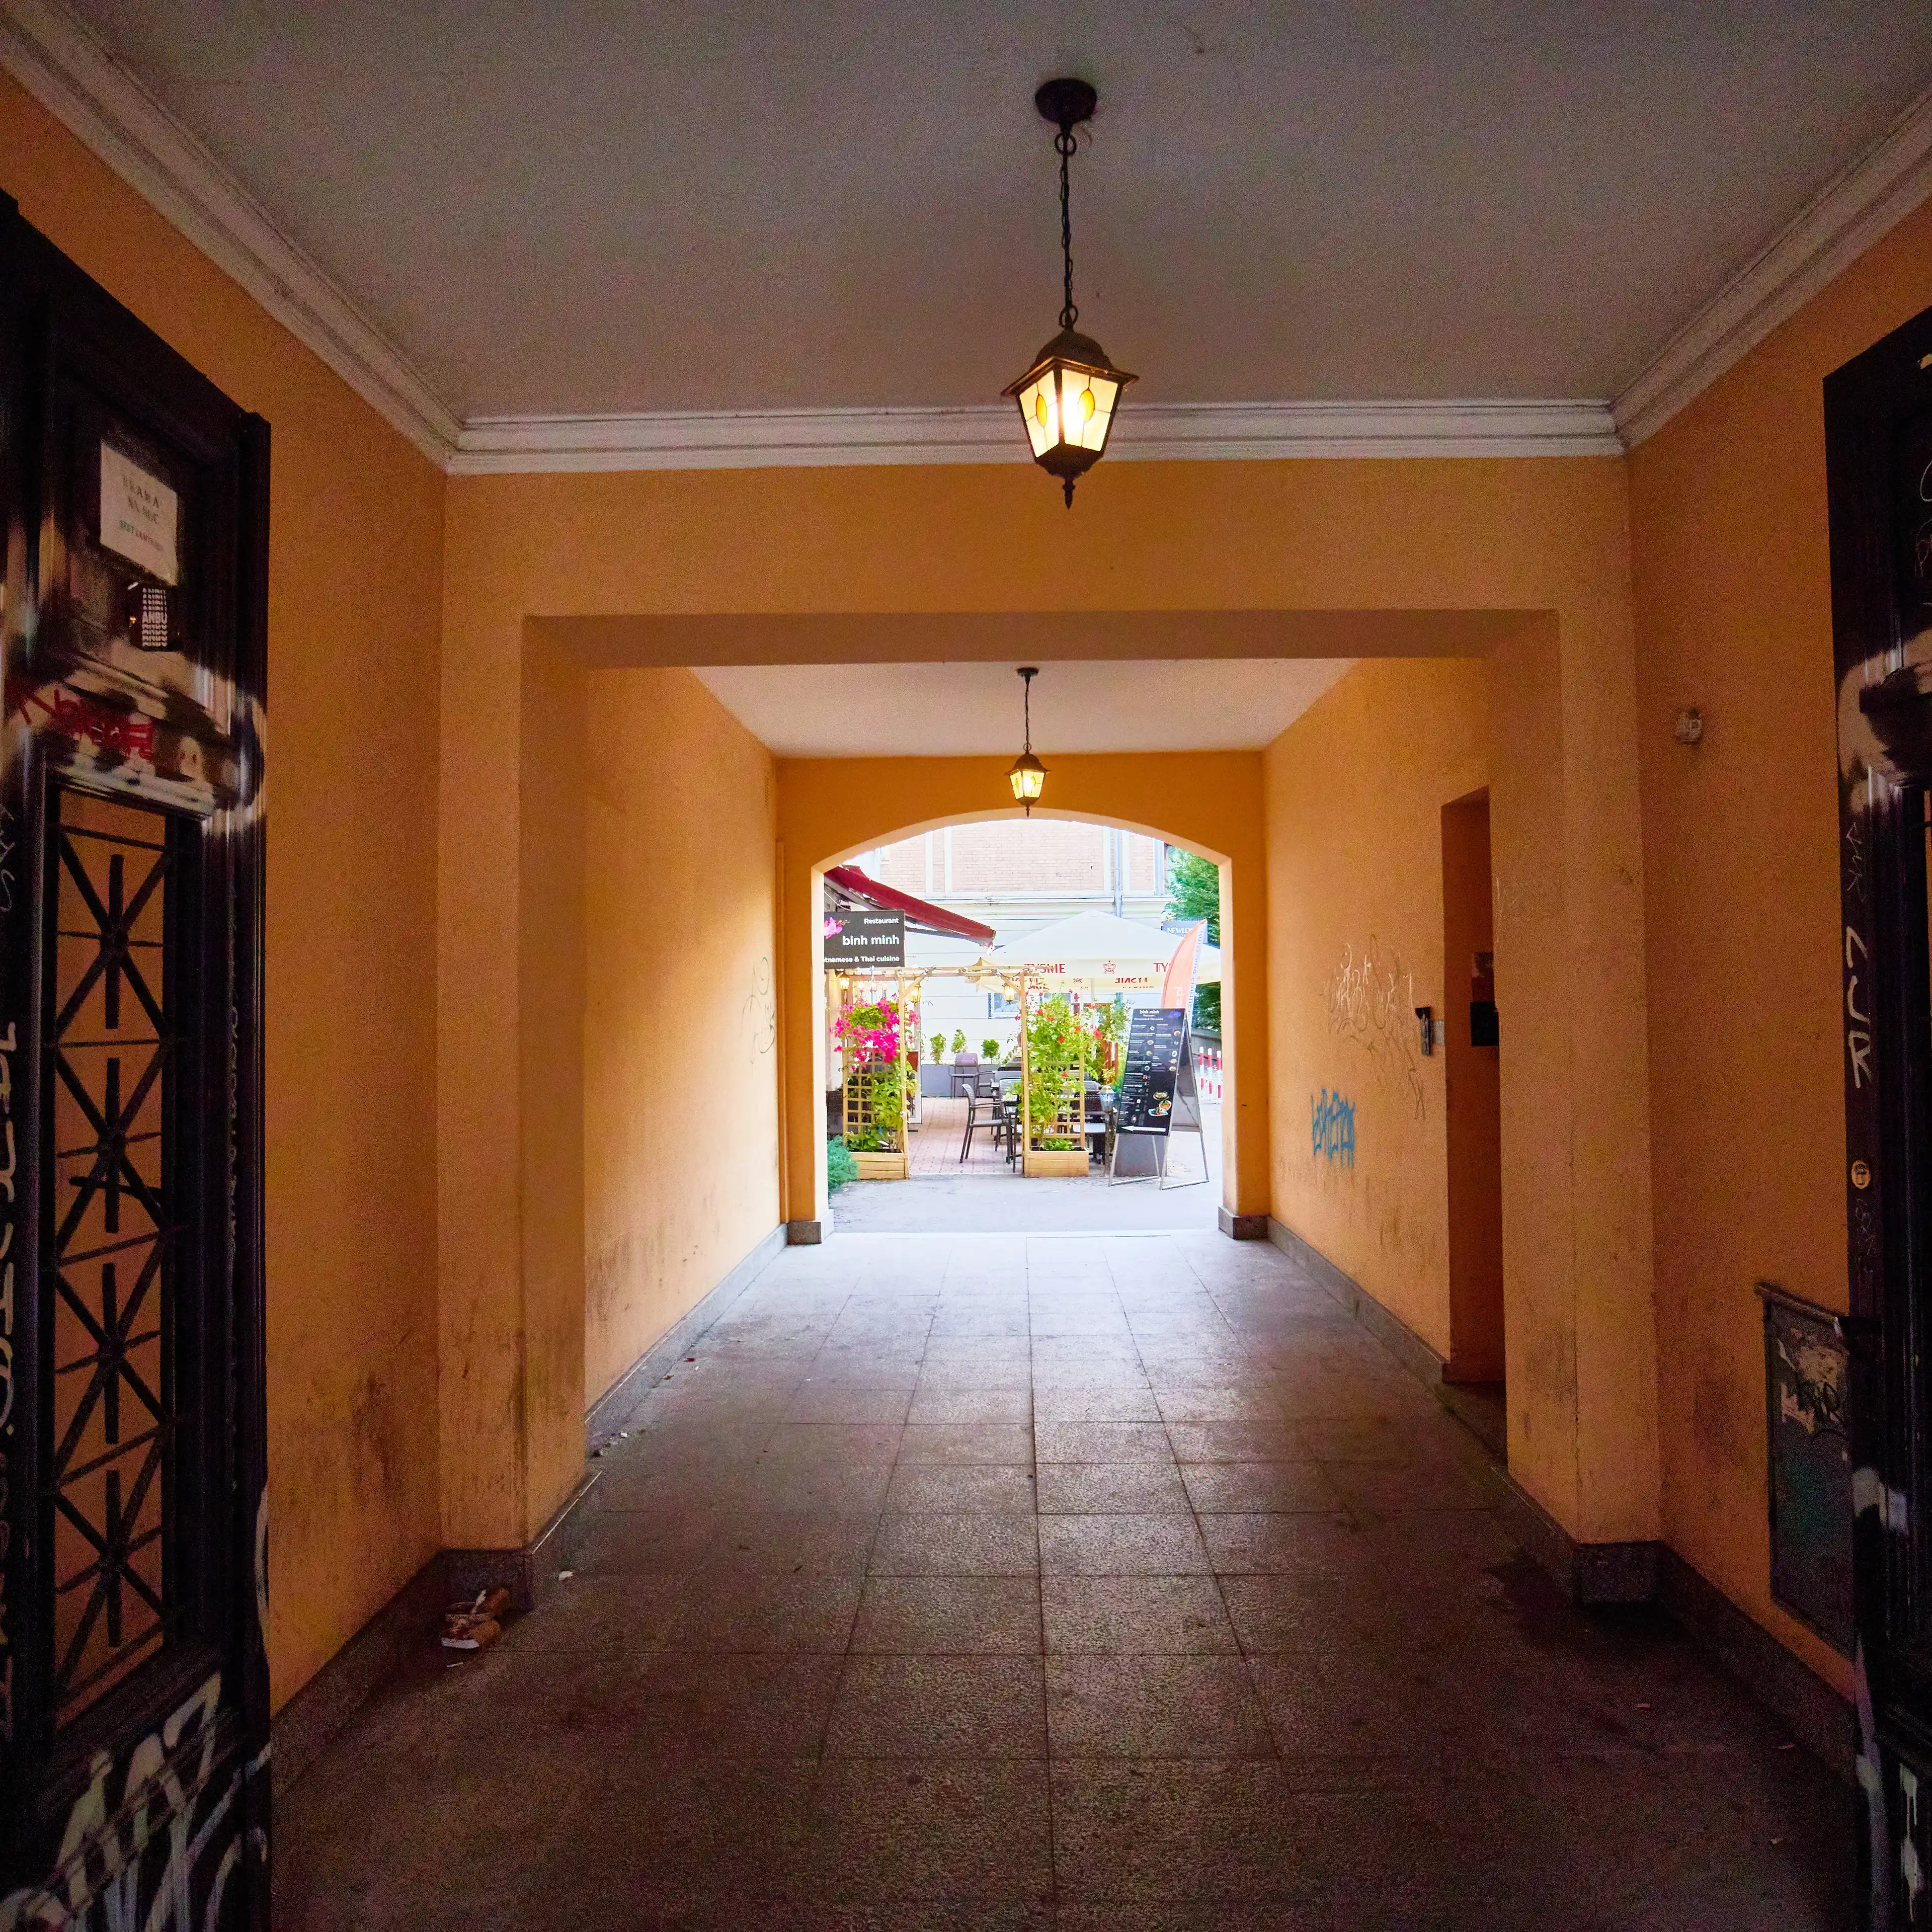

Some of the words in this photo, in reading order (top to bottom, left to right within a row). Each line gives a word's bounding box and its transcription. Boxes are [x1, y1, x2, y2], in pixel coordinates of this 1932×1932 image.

[843, 935, 868, 946] binh
[871, 934, 900, 945] minh
[1153, 962, 1171, 972] TY
